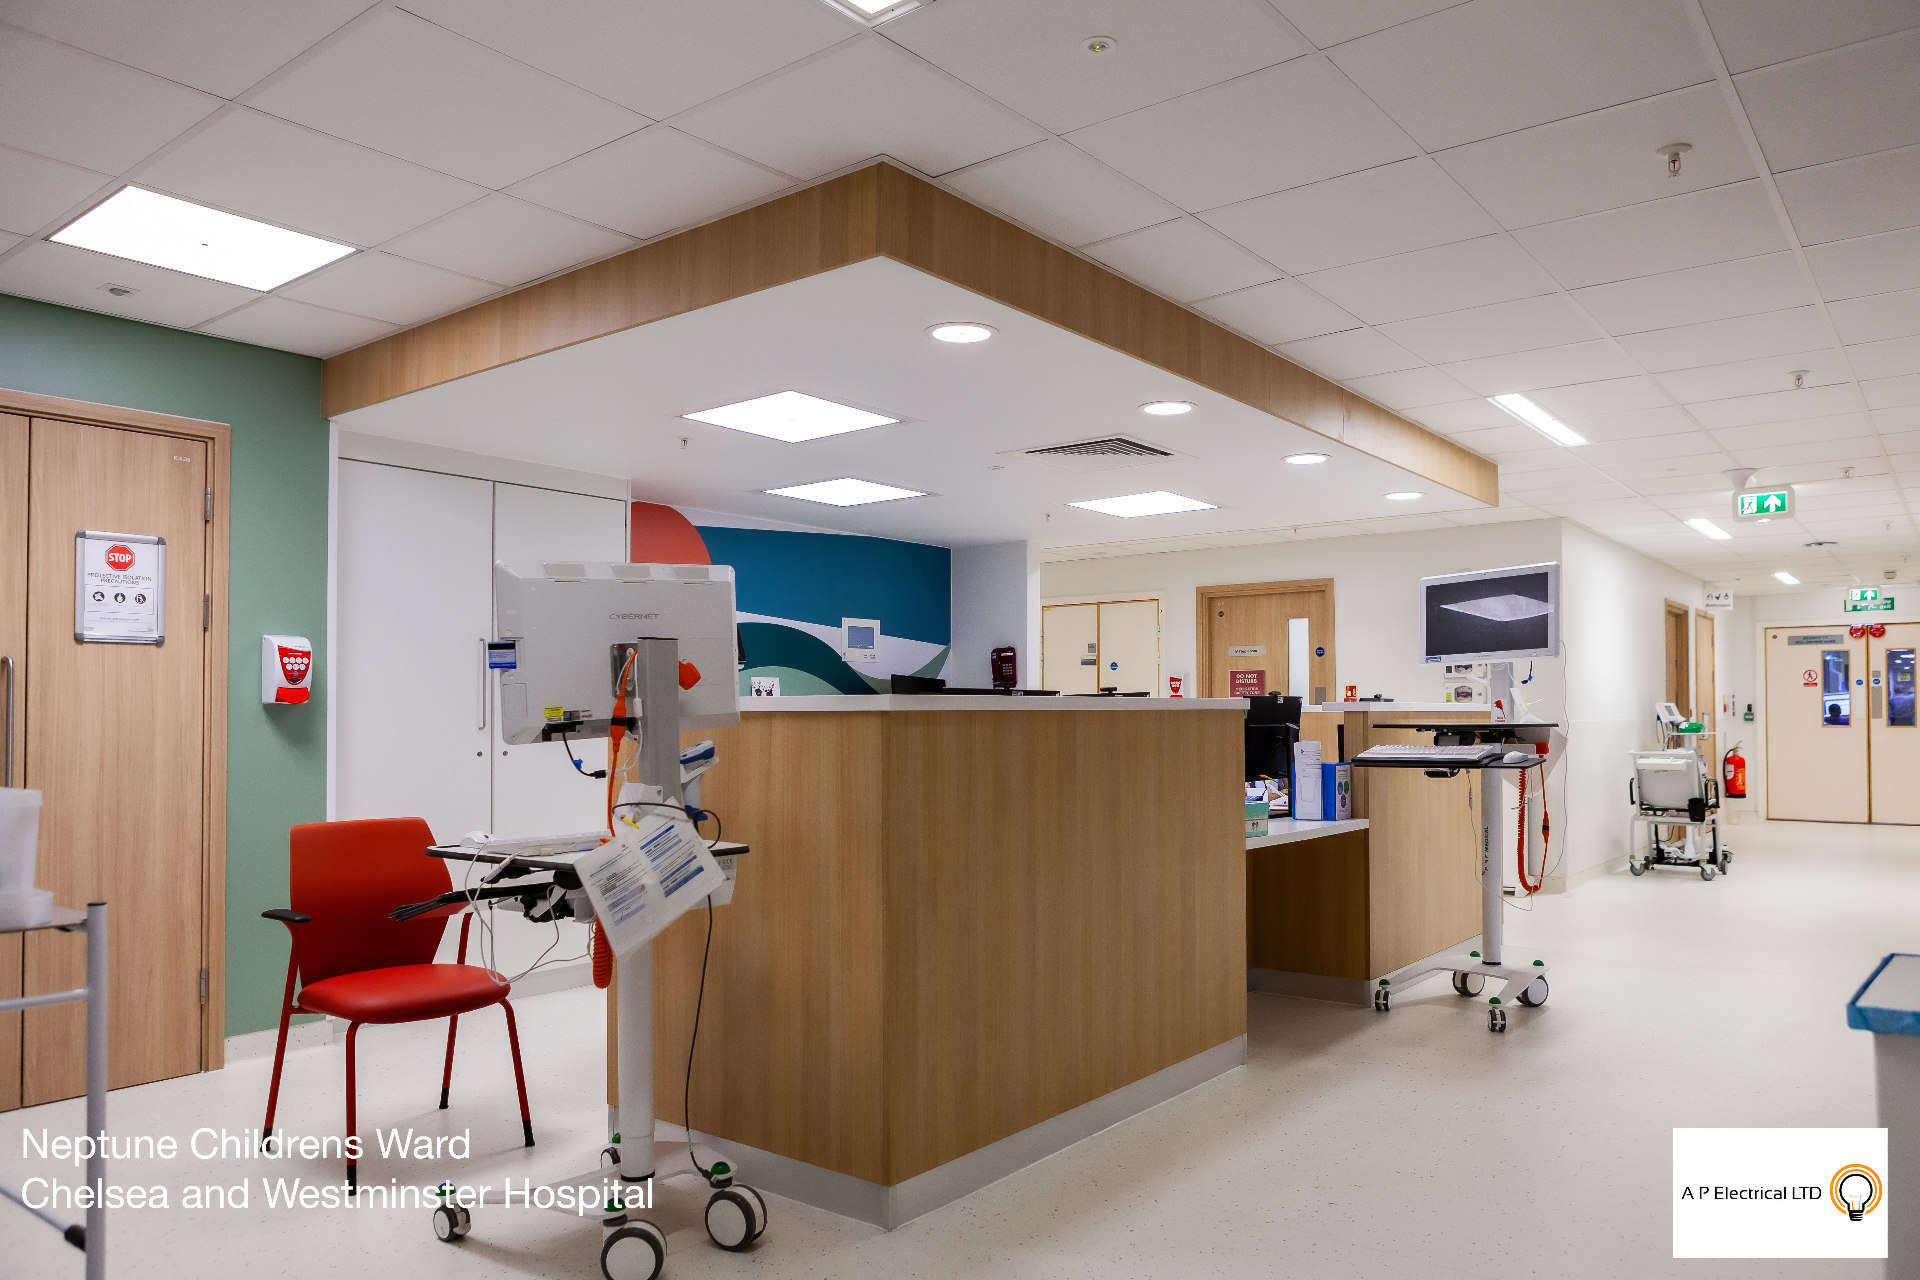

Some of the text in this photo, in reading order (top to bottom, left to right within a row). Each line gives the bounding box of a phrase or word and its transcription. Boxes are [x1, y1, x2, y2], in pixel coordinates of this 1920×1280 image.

[108, 552, 132, 563] STOP
[87, 572, 152, 582] PROTECTIVE ISOLATION
[100, 578, 140, 586] PRECAUTIONS
